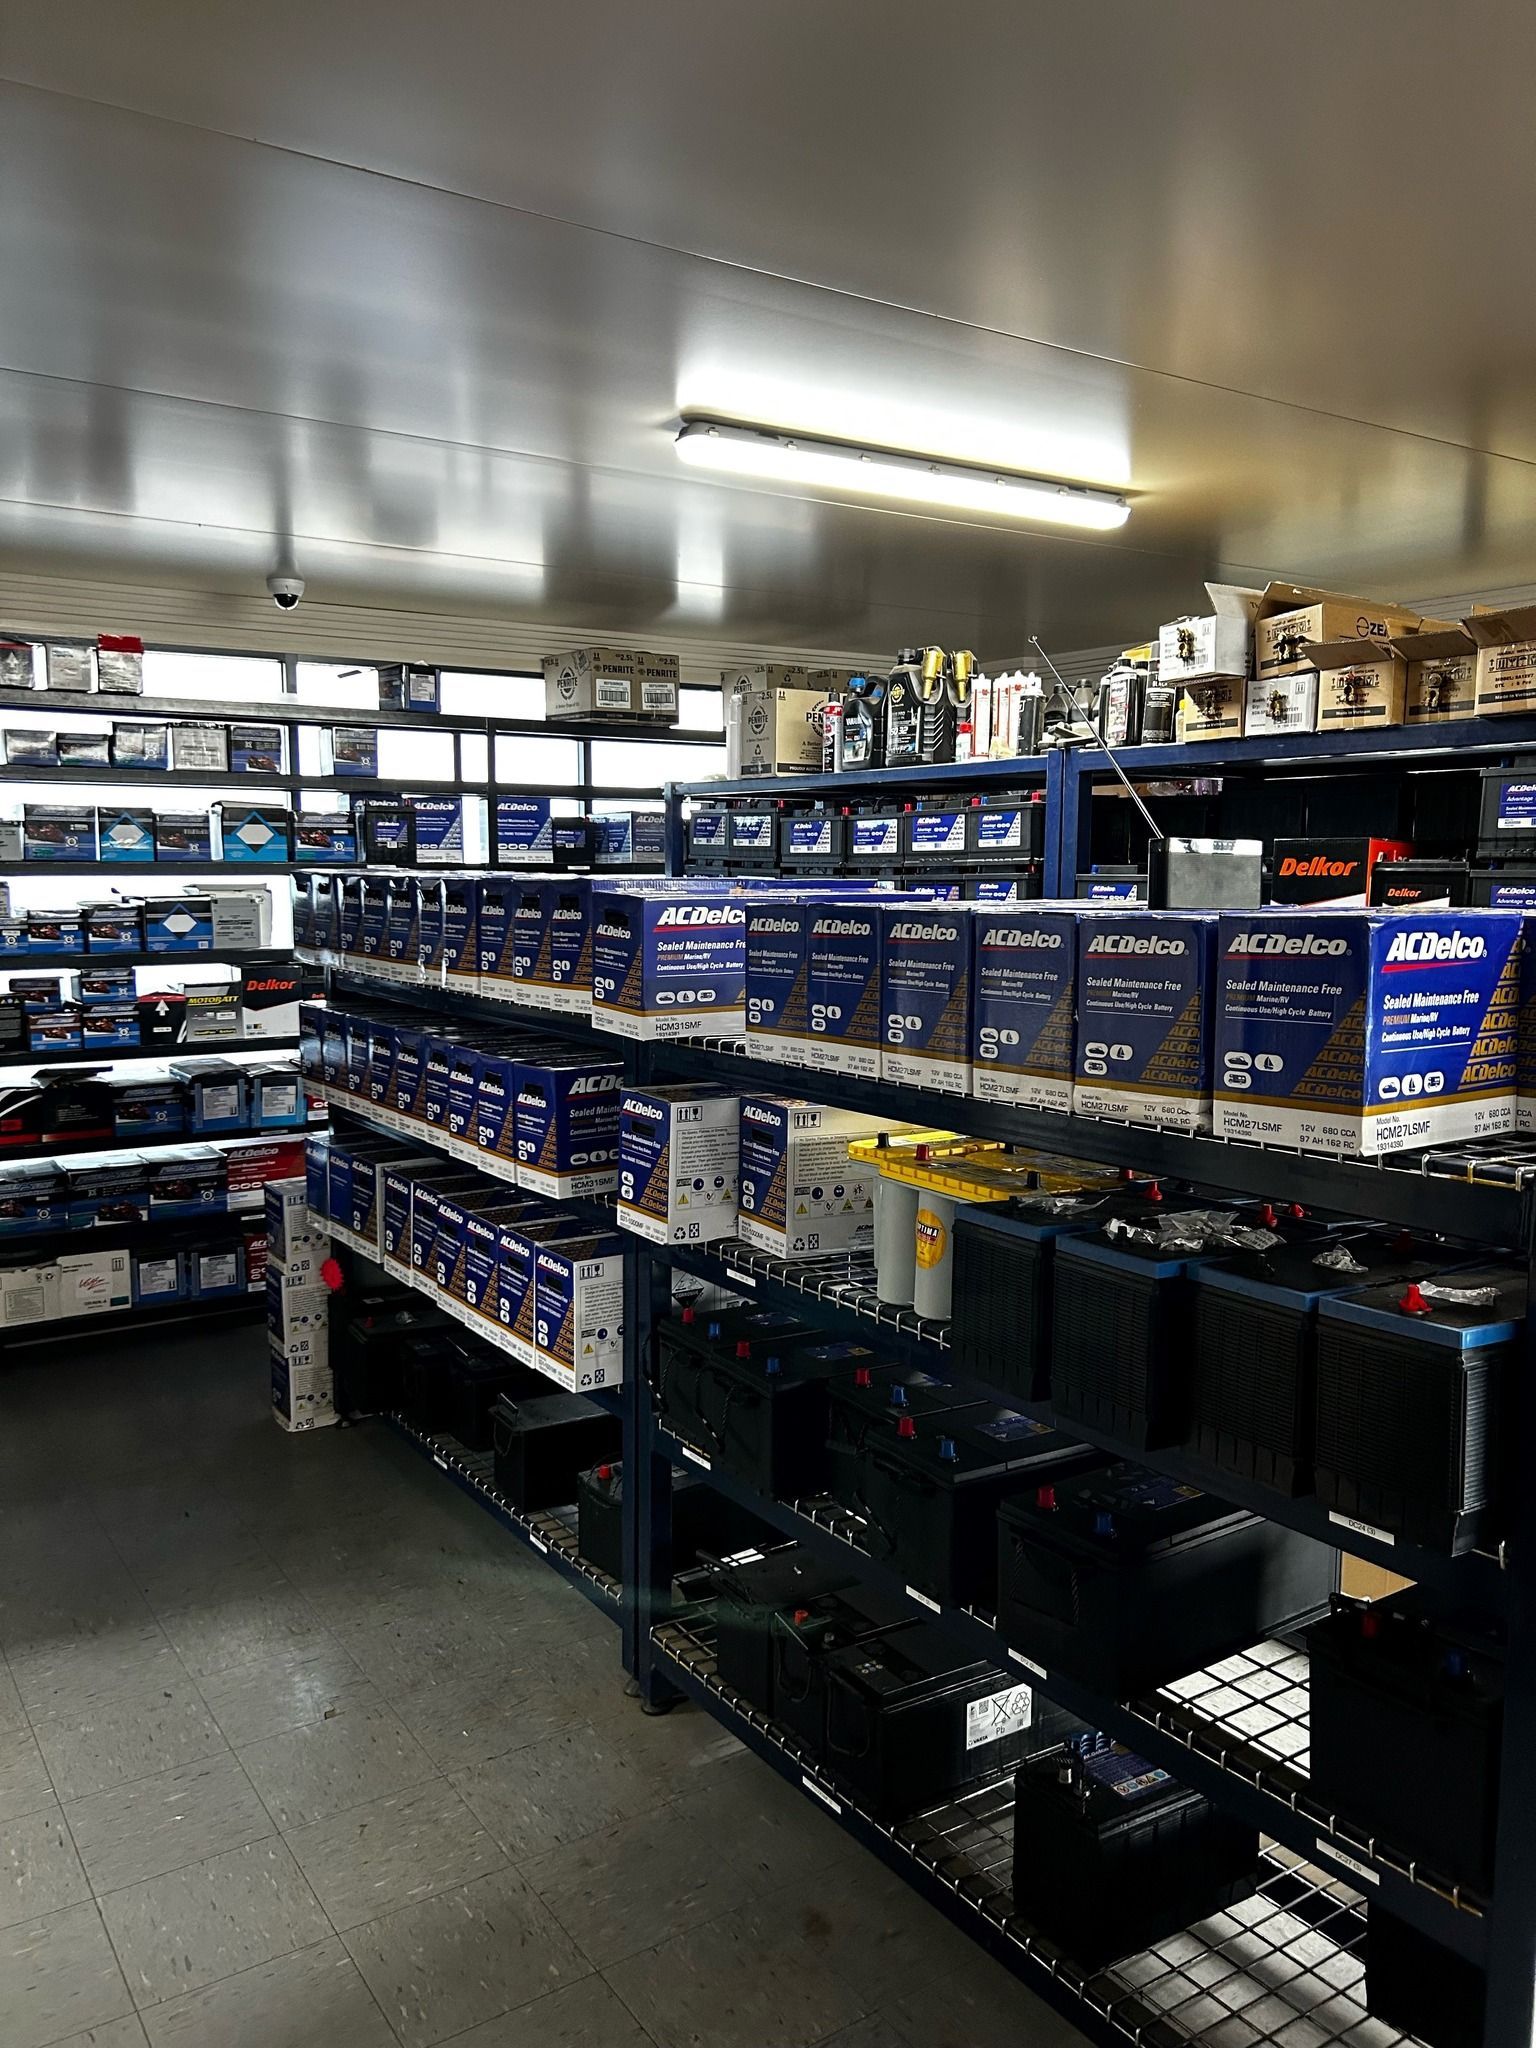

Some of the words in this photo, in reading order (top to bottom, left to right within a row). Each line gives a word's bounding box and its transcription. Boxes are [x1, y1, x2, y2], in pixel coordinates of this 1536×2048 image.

[603, 665, 634, 674] PENRITE
[647, 669, 677, 678] PENRITE
[557, 677, 578, 688] PENRITE
[734, 683, 752, 694] PENRITE
[761, 692, 773, 700] 2.5L
[748, 714, 768, 724] PENRITE
[497, 803, 538, 811] ACDelco
[1279, 856, 1356, 877] Delkor
[1387, 888, 1421, 898] Delkor
[481, 905, 505, 916] ACDelco
[514, 908, 542, 919] ACDelco
[552, 909, 582, 920] ACDelco
[657, 906, 745, 925] ACDelc
[596, 924, 631, 939] ACDelco
[749, 918, 799, 933] ACDelco
[813, 920, 870, 935] ACDelco
[890, 923, 957, 940] ACDelco
[983, 929, 1061, 948] ACDelco
[1088, 935, 1185, 955] ACDelco
[1228, 934, 1347, 955] ACDelco
[657, 941, 684, 951] Sealed
[686, 941, 734, 950] Maintenance
[1386, 931, 1484, 961] ACDelco
[858, 955, 869, 963] Free
[888, 959, 906, 967] Sealed
[907, 960, 941, 969] Maintenance
[943, 962, 955, 971] Free
[981, 968, 1002, 976] Sealed
[1003, 969, 1042, 979] Maintenance
[1044, 972, 1058, 981] Free
[247, 979, 297, 991] Delkor
[1087, 977, 1112, 987] Sealed
[1114, 979, 1164, 989] Maintenance
[1165, 981, 1181, 990] Free
[1226, 980, 1257, 990] Sealed
[1259, 981, 1319, 993] Maintenance
[1321, 984, 1342, 994] Free
[188, 995, 239, 1005] MOTOBATT
[1256, 995, 1289, 1003] Marine/RV
[1383, 993, 1412, 1009] Sealed
[1413, 992, 1462, 1007] Maintenance
[1463, 990, 1479, 1004] Free
[1154, 1004, 1173, 1012] Battery
[1225, 1004, 1257, 1013] Continuous
[1259, 1007, 1287, 1016] Use/High
[1288, 1008, 1305, 1016] Cycle
[1309, 1010, 1331, 1018] Battery
[1383, 1014, 1410, 1025] PREMIUM
[1410, 1012, 1438, 1023] Marine/RV
[656, 1021, 702, 1031] HCM31SMF
[1382, 1032, 1411, 1042] Continuous
[1412, 1028, 1436, 1040] Use/High
[1436, 1027, 1450, 1039] Cycle
[1452, 1026, 1470, 1036] Battery
[398, 1052, 419, 1065] ACDelco
[427, 1061, 449, 1074] ACDelco
[1461, 1062, 1516, 1083] ACDelco
[450, 1071, 474, 1085] ACDelco
[1141, 1070, 1198, 1083] ACDelco
[478, 1081, 505, 1096] ACDelco
[980, 1083, 1020, 1094] HCM27LSMF
[1293, 1082, 1362, 1098] ACDelco
[517, 1092, 547, 1108] ACDelco
[570, 1107, 594, 1118] Sealed
[623, 1098, 662, 1120] ACDelco
[1081, 1101, 1128, 1113] HCM27LSMF
[743, 1106, 781, 1127] ACDelco
[1475, 1112, 1484, 1120] 12V
[1489, 1110, 1499, 1118] 680
[1501, 1108, 1511, 1116] CCA
[1224, 1118, 1282, 1132] HCM27LSMF
[1301, 1124, 1315, 1132] 12V
[1323, 1127, 1338, 1135] 680
[1341, 1129, 1356, 1137] CCA
[1475, 1124, 1482, 1133] 97
[1483, 1123, 1490, 1132] AH
[1492, 1121, 1501, 1130] 162
[1502, 1120, 1510, 1128] RC
[1520, 1120, 1531, 1128] RC
[1377, 1121, 1430, 1141] HCM27LSMF
[1312, 1137, 1323, 1145] AH
[1327, 1139, 1340, 1147] 162
[1377, 1140, 1403, 1151] 19314390
[229, 1148, 279, 1158] ACDelco
[387, 1177, 408, 1194] ACDelco
[571, 1176, 615, 1189] HCM31SMF
[640, 1197, 667, 1213] ACDelco
[438, 1205, 463, 1224] ACDelco
[467, 1220, 494, 1240] ACDelco
[500, 1235, 530, 1257] ACDelco
[538, 1254, 569, 1277] ACDelco
[1349, 1520, 1365, 1531] DC24
[995, 1726, 1005, 1735] Pb
[973, 1736, 988, 1744] VARTA
